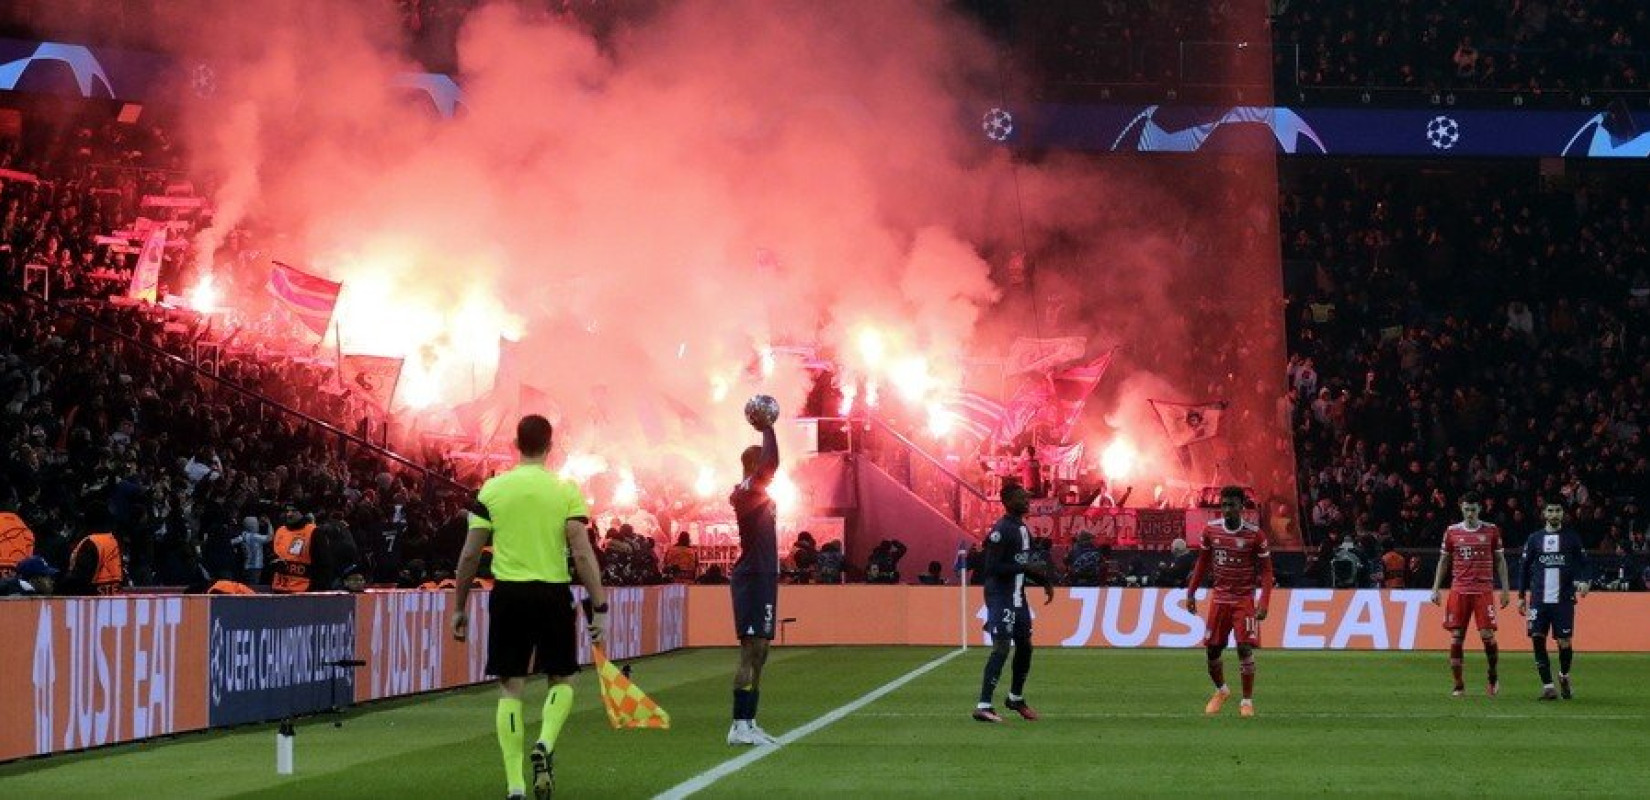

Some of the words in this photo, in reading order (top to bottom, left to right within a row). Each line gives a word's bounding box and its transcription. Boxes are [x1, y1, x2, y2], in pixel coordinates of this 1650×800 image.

[764, 604, 773, 620] 3
[1061, 588, 1262, 647] JUS
[1282, 589, 1433, 650] EAT
[64, 599, 128, 750] JUST
[133, 599, 182, 739] EAT
[226, 629, 256, 691] UEFA
[384, 592, 418, 697] JUST
[420, 592, 446, 692] EAT
